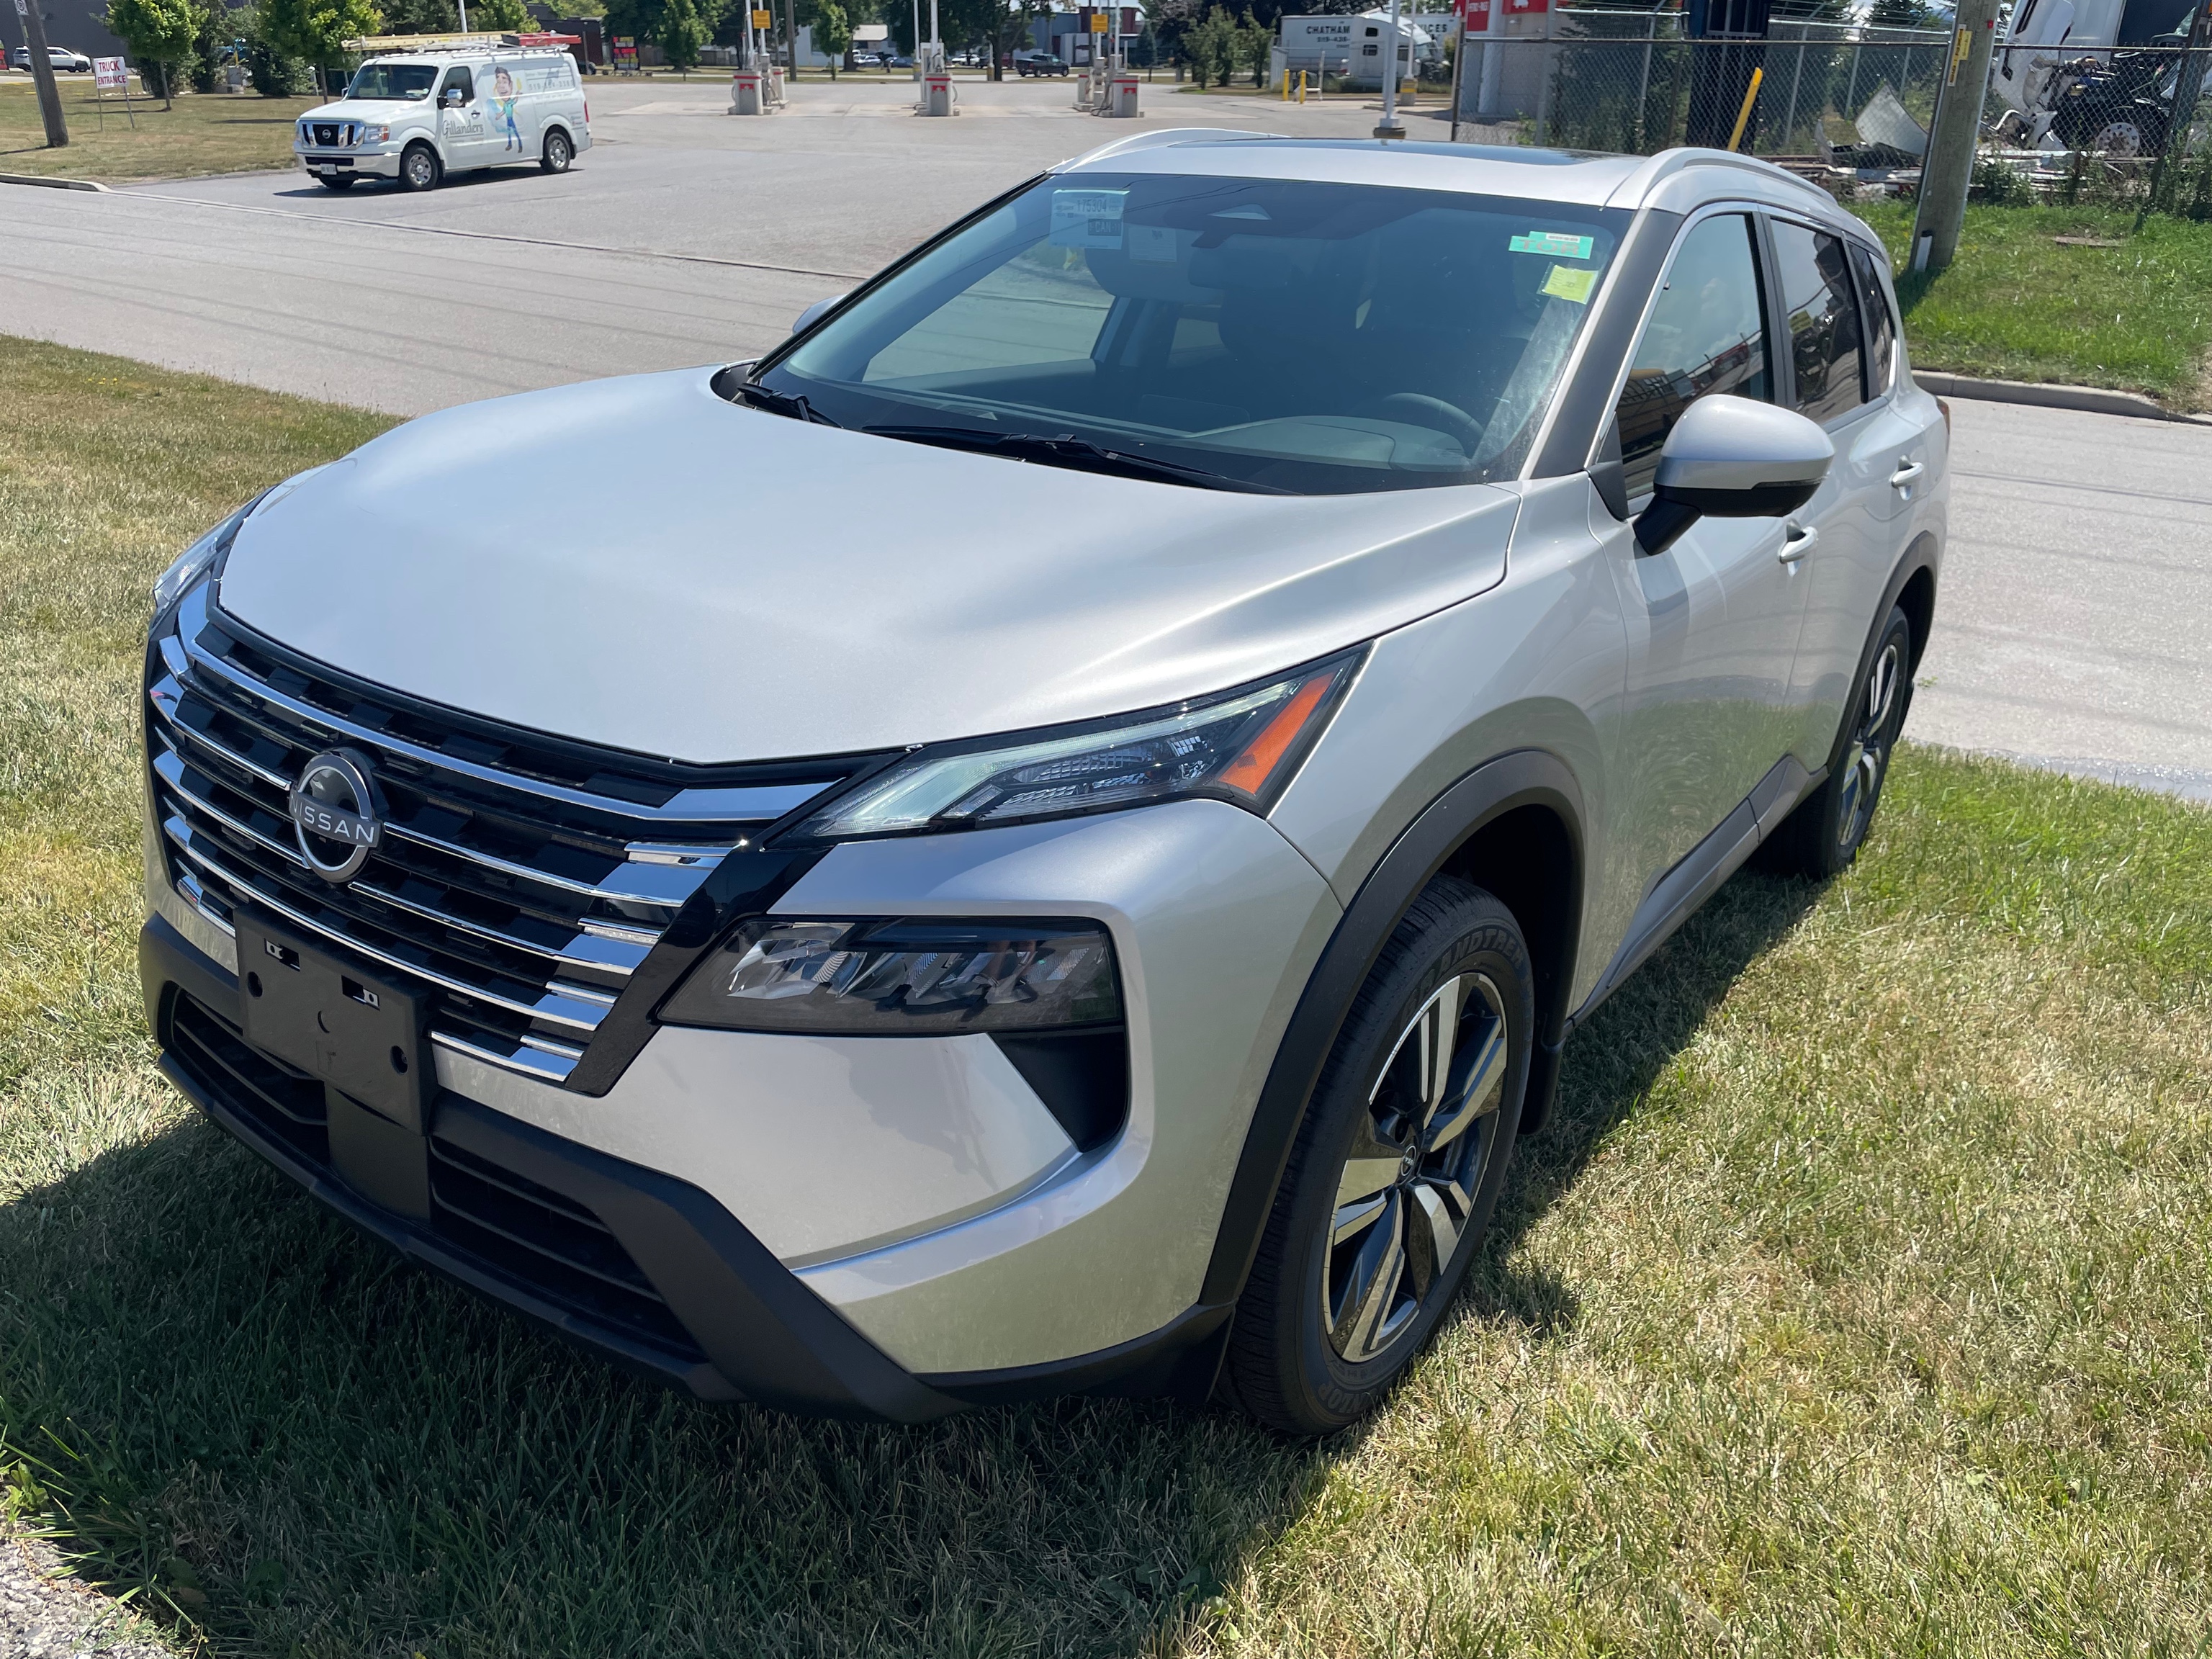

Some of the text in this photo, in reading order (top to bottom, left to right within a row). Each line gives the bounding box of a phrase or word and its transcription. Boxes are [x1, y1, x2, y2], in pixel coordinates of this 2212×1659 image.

[1306, 25, 1351, 35] CHATHAM
[98, 60, 120, 73] TRUCK
[97, 75, 127, 85] ENTRANCE
[442, 119, 484, 139] Gillanders
[1519, 238, 1580, 256] TOR
[290, 793, 374, 843] NISSAN
